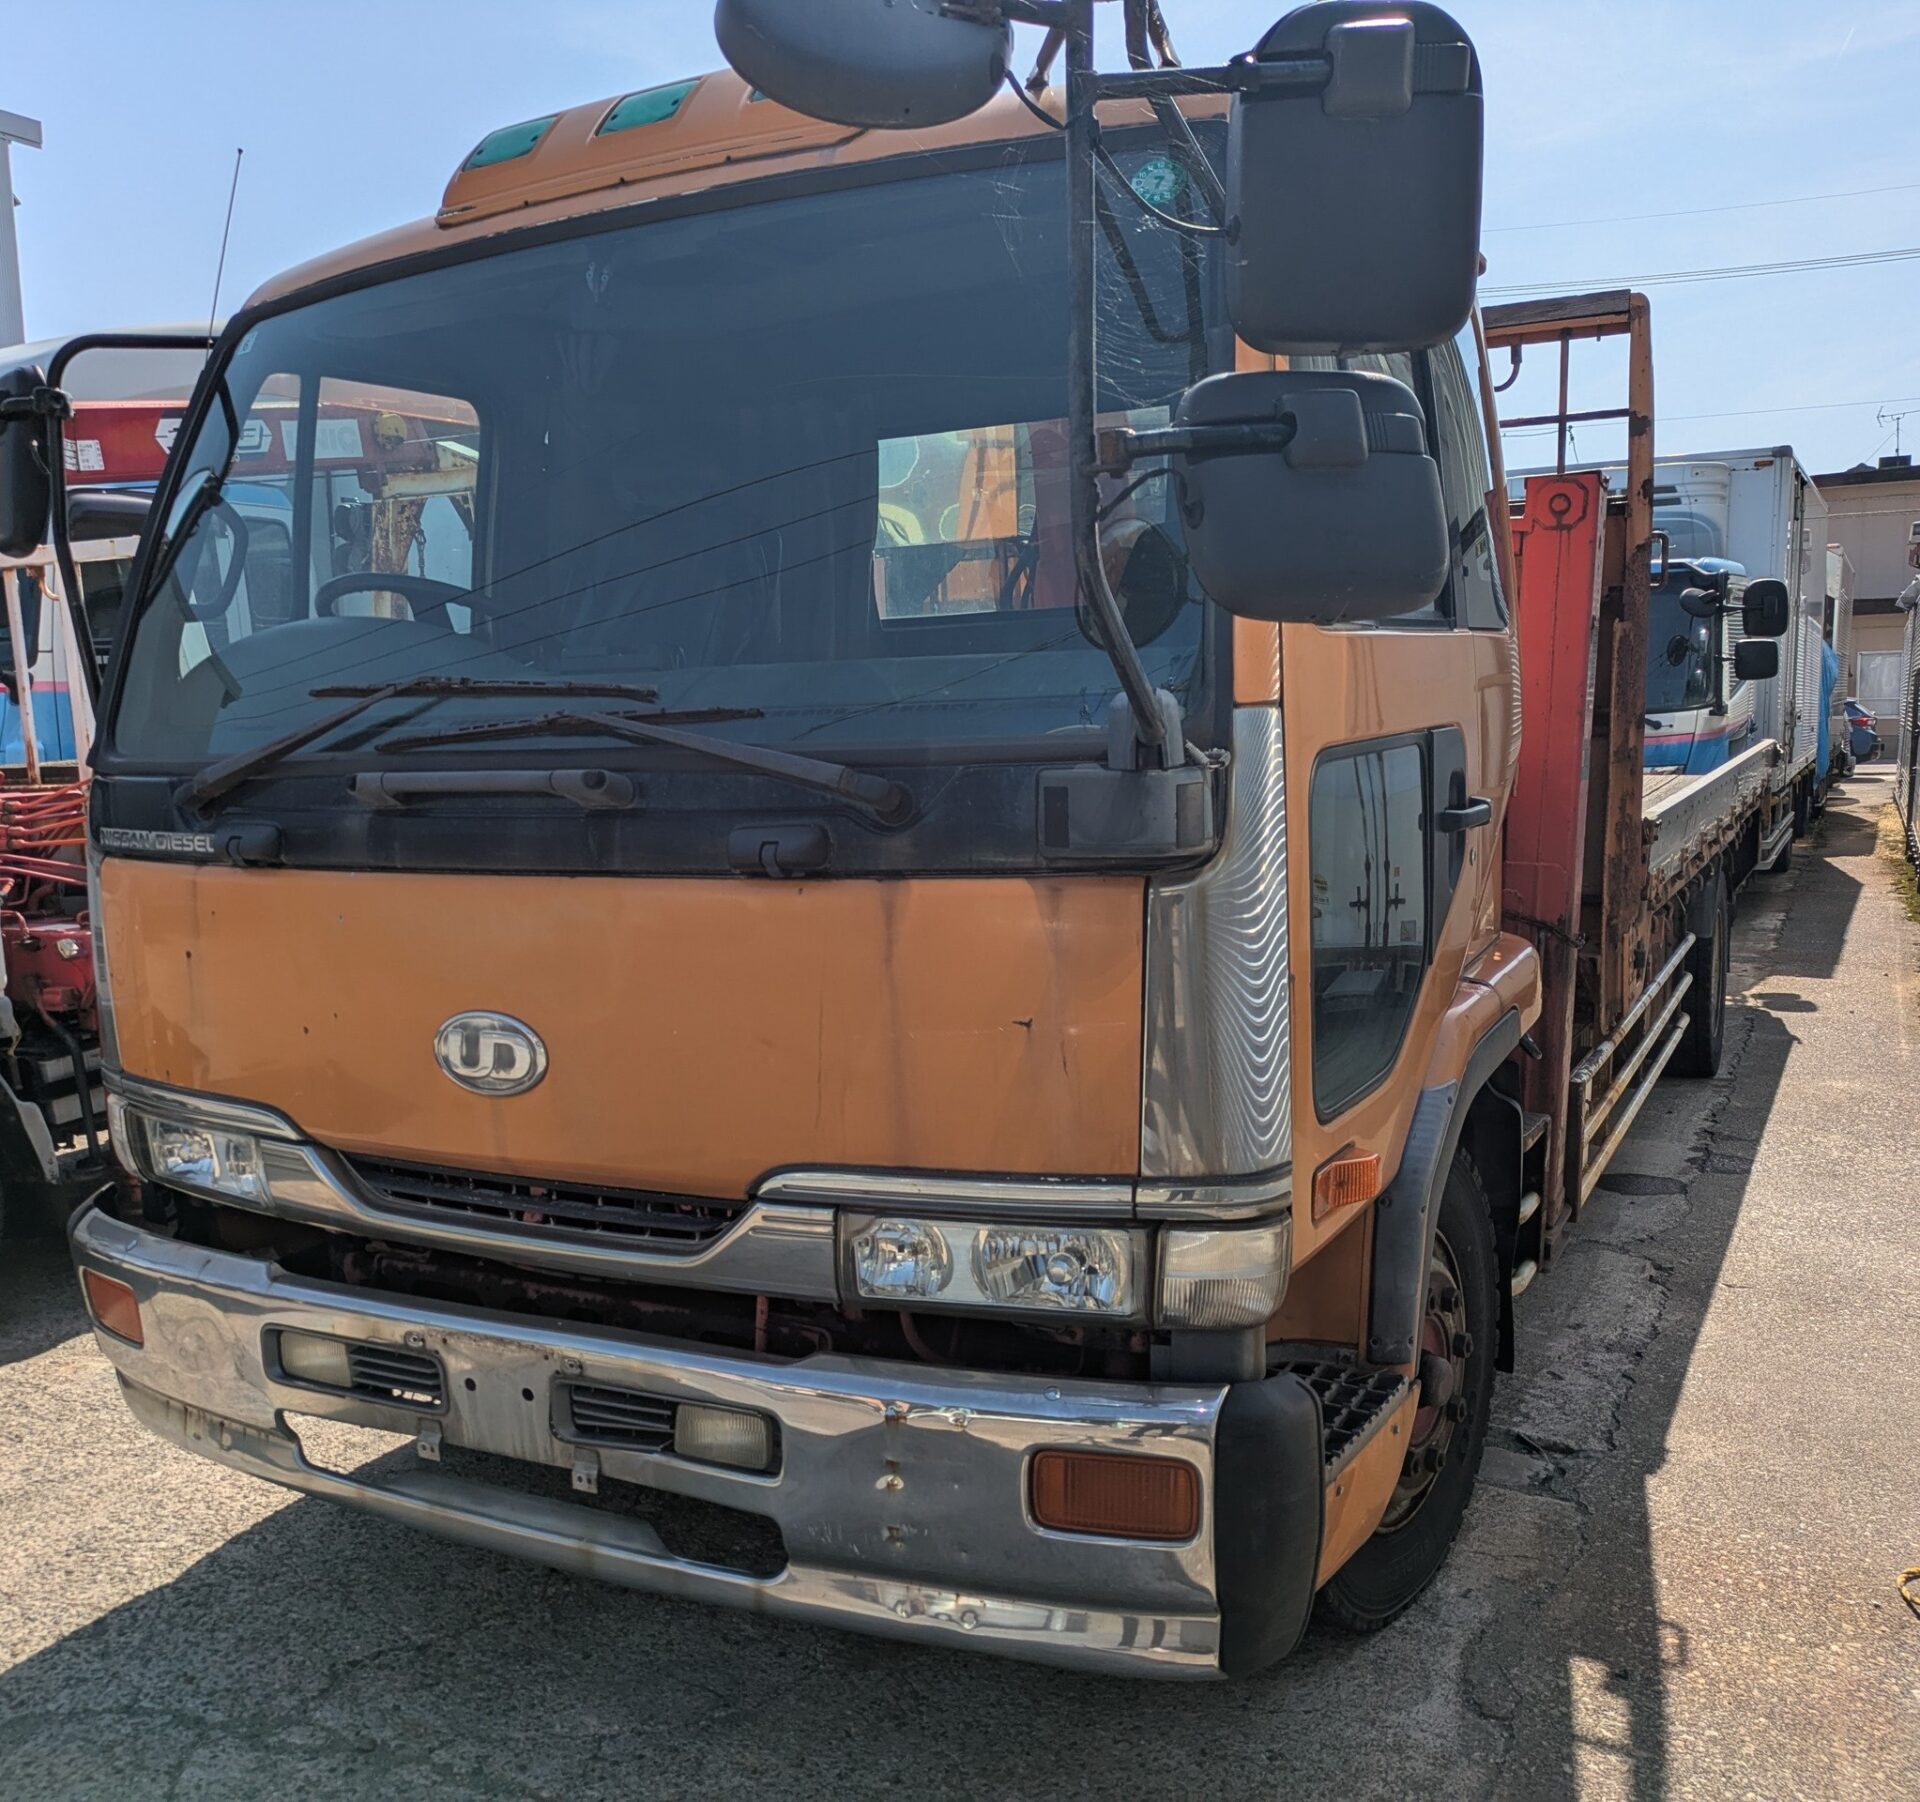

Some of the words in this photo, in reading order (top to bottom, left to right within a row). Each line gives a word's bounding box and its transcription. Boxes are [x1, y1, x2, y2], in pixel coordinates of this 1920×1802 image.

[1154, 175, 1166, 189] 7
[100, 828, 150, 849] NISSAN
[154, 833, 215, 853] DIESEL
[447, 1028, 532, 1080] UD
